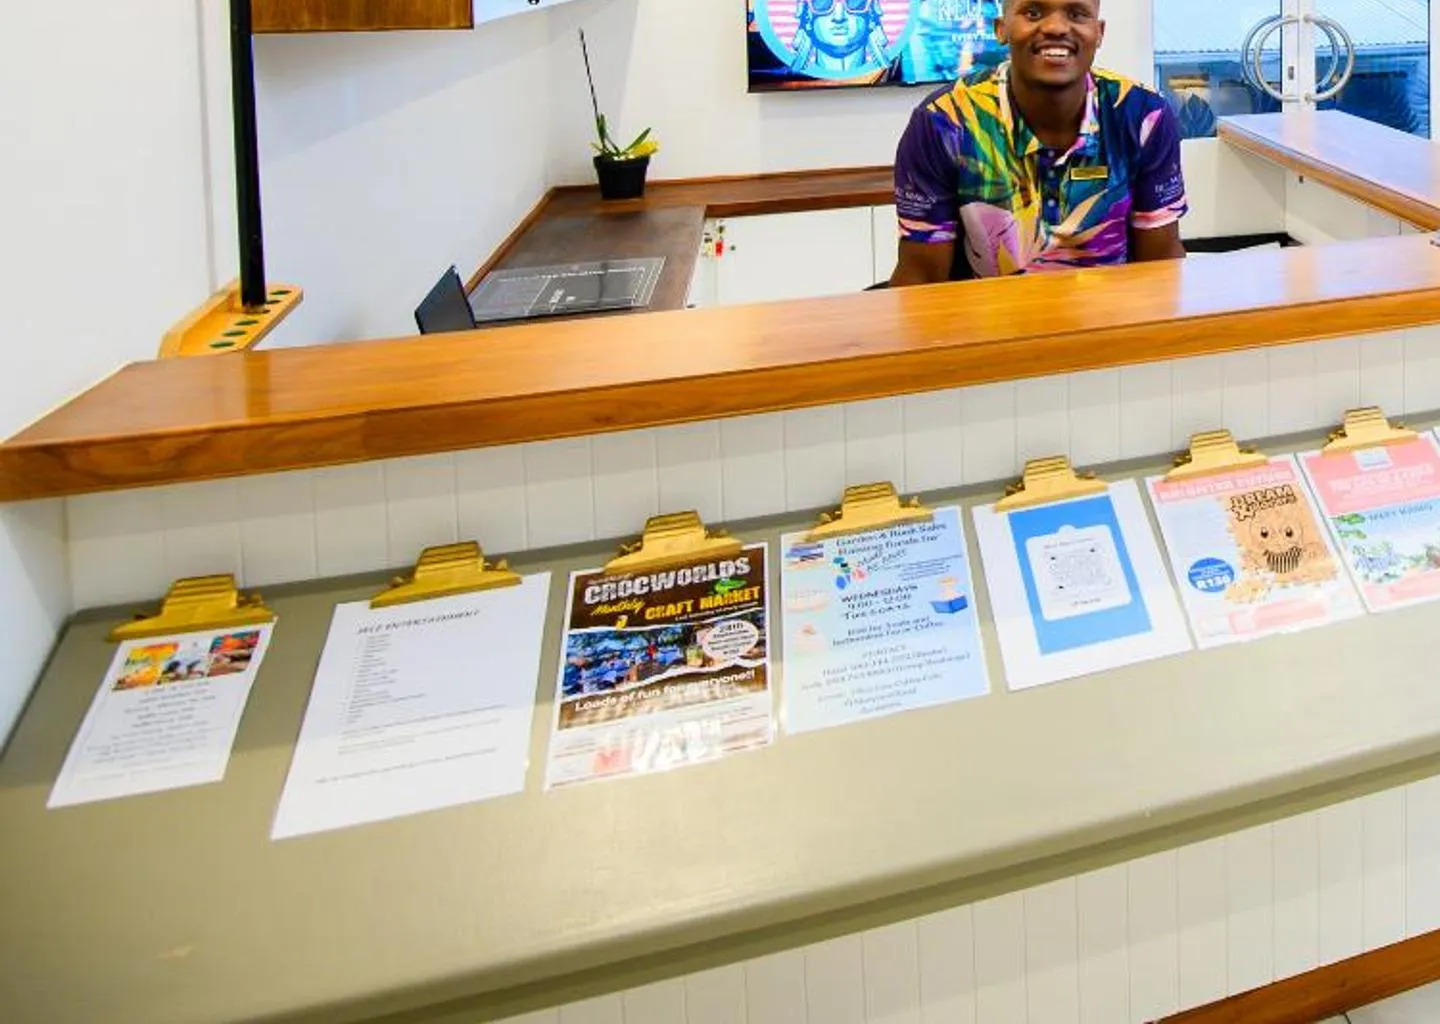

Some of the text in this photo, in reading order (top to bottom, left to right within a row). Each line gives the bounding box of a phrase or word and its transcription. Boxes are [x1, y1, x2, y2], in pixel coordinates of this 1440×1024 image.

[584, 557, 751, 605] CROCWORLDS
[644, 585, 761, 621] CRAFT MARKET
[575, 697, 618, 712] Loads
[619, 690, 636, 703] of
[637, 687, 661, 700] fun
